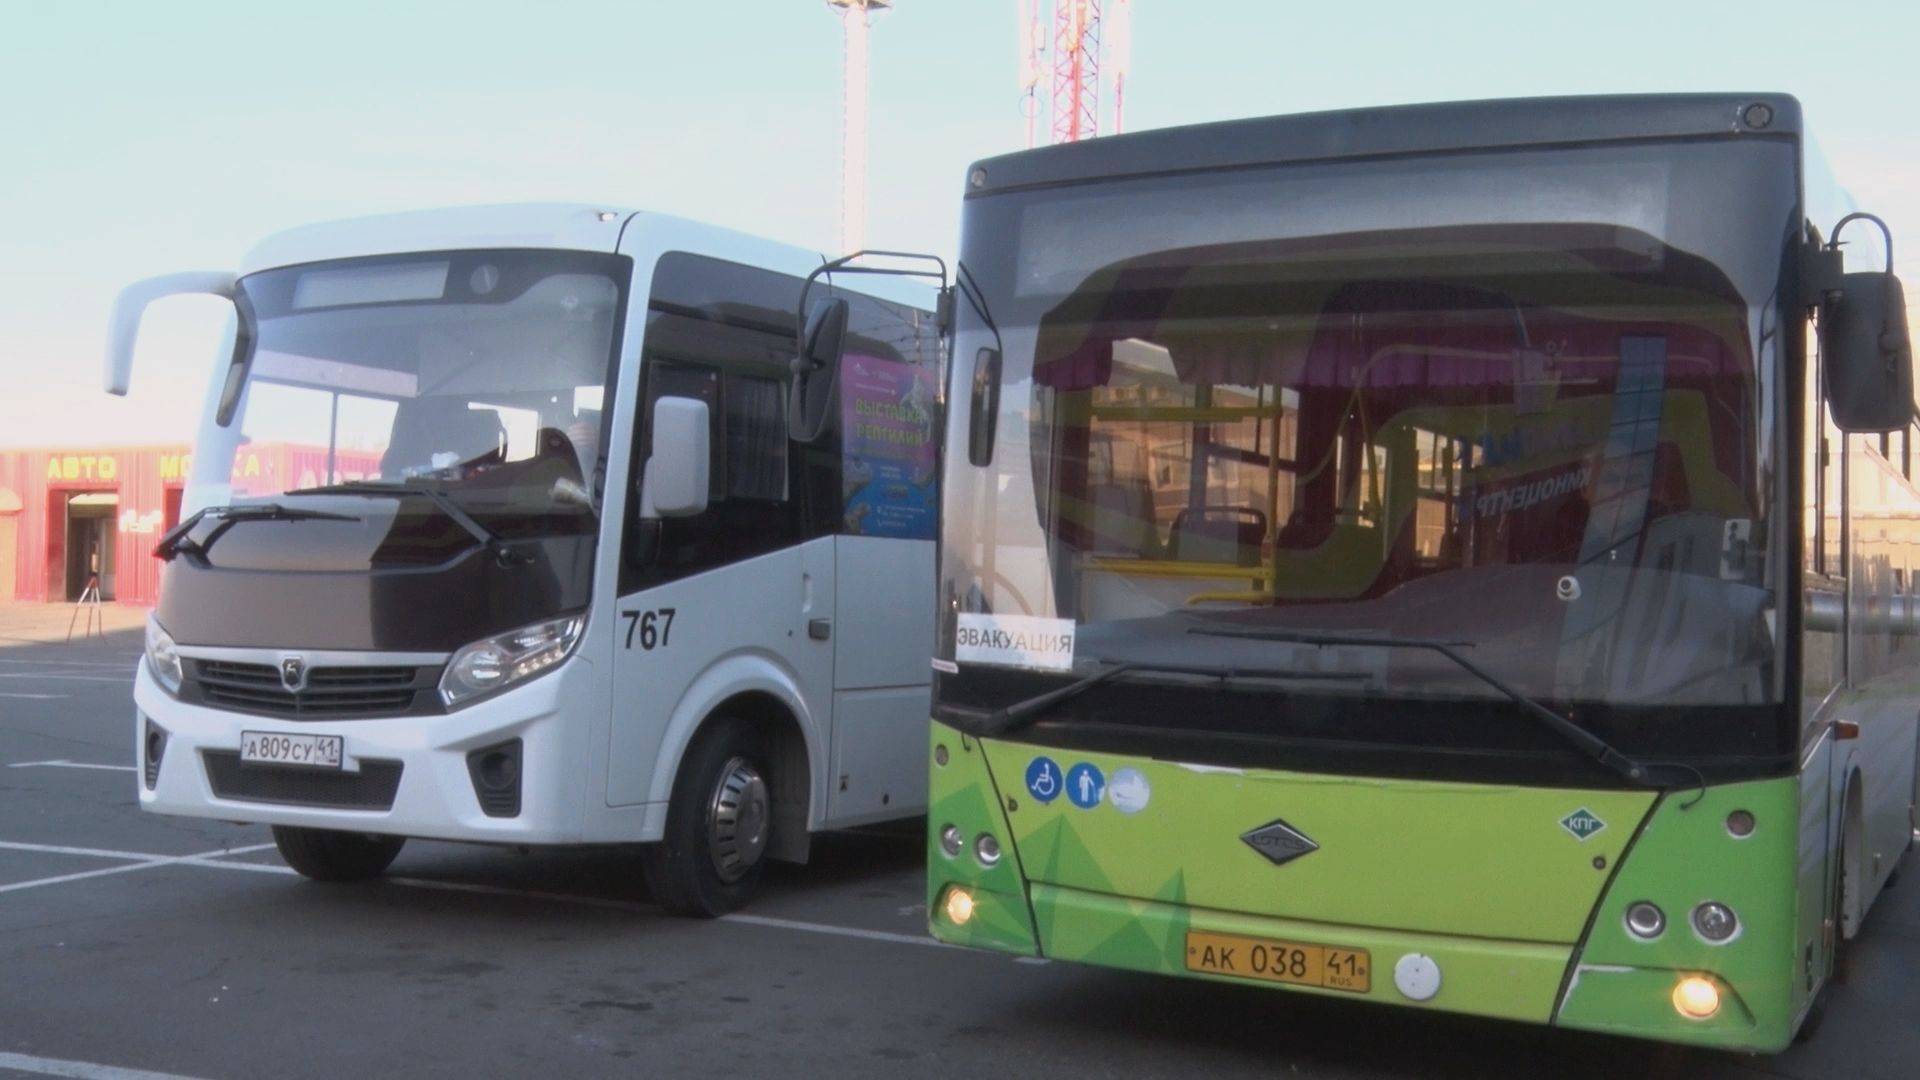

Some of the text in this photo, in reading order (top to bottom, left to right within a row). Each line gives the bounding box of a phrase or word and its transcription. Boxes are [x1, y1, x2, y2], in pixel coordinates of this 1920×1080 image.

[48, 456, 116, 479] АВТО
[622, 608, 676, 651] 767
[958, 628, 1072, 653] ЭВАКУАЦИЯ
[247, 737, 334, 760] А809СУ 41
[1569, 817, 1596, 830] КПГ
[1201, 944, 1358, 977] АК 038 41
[1330, 975, 1353, 986] RUS
